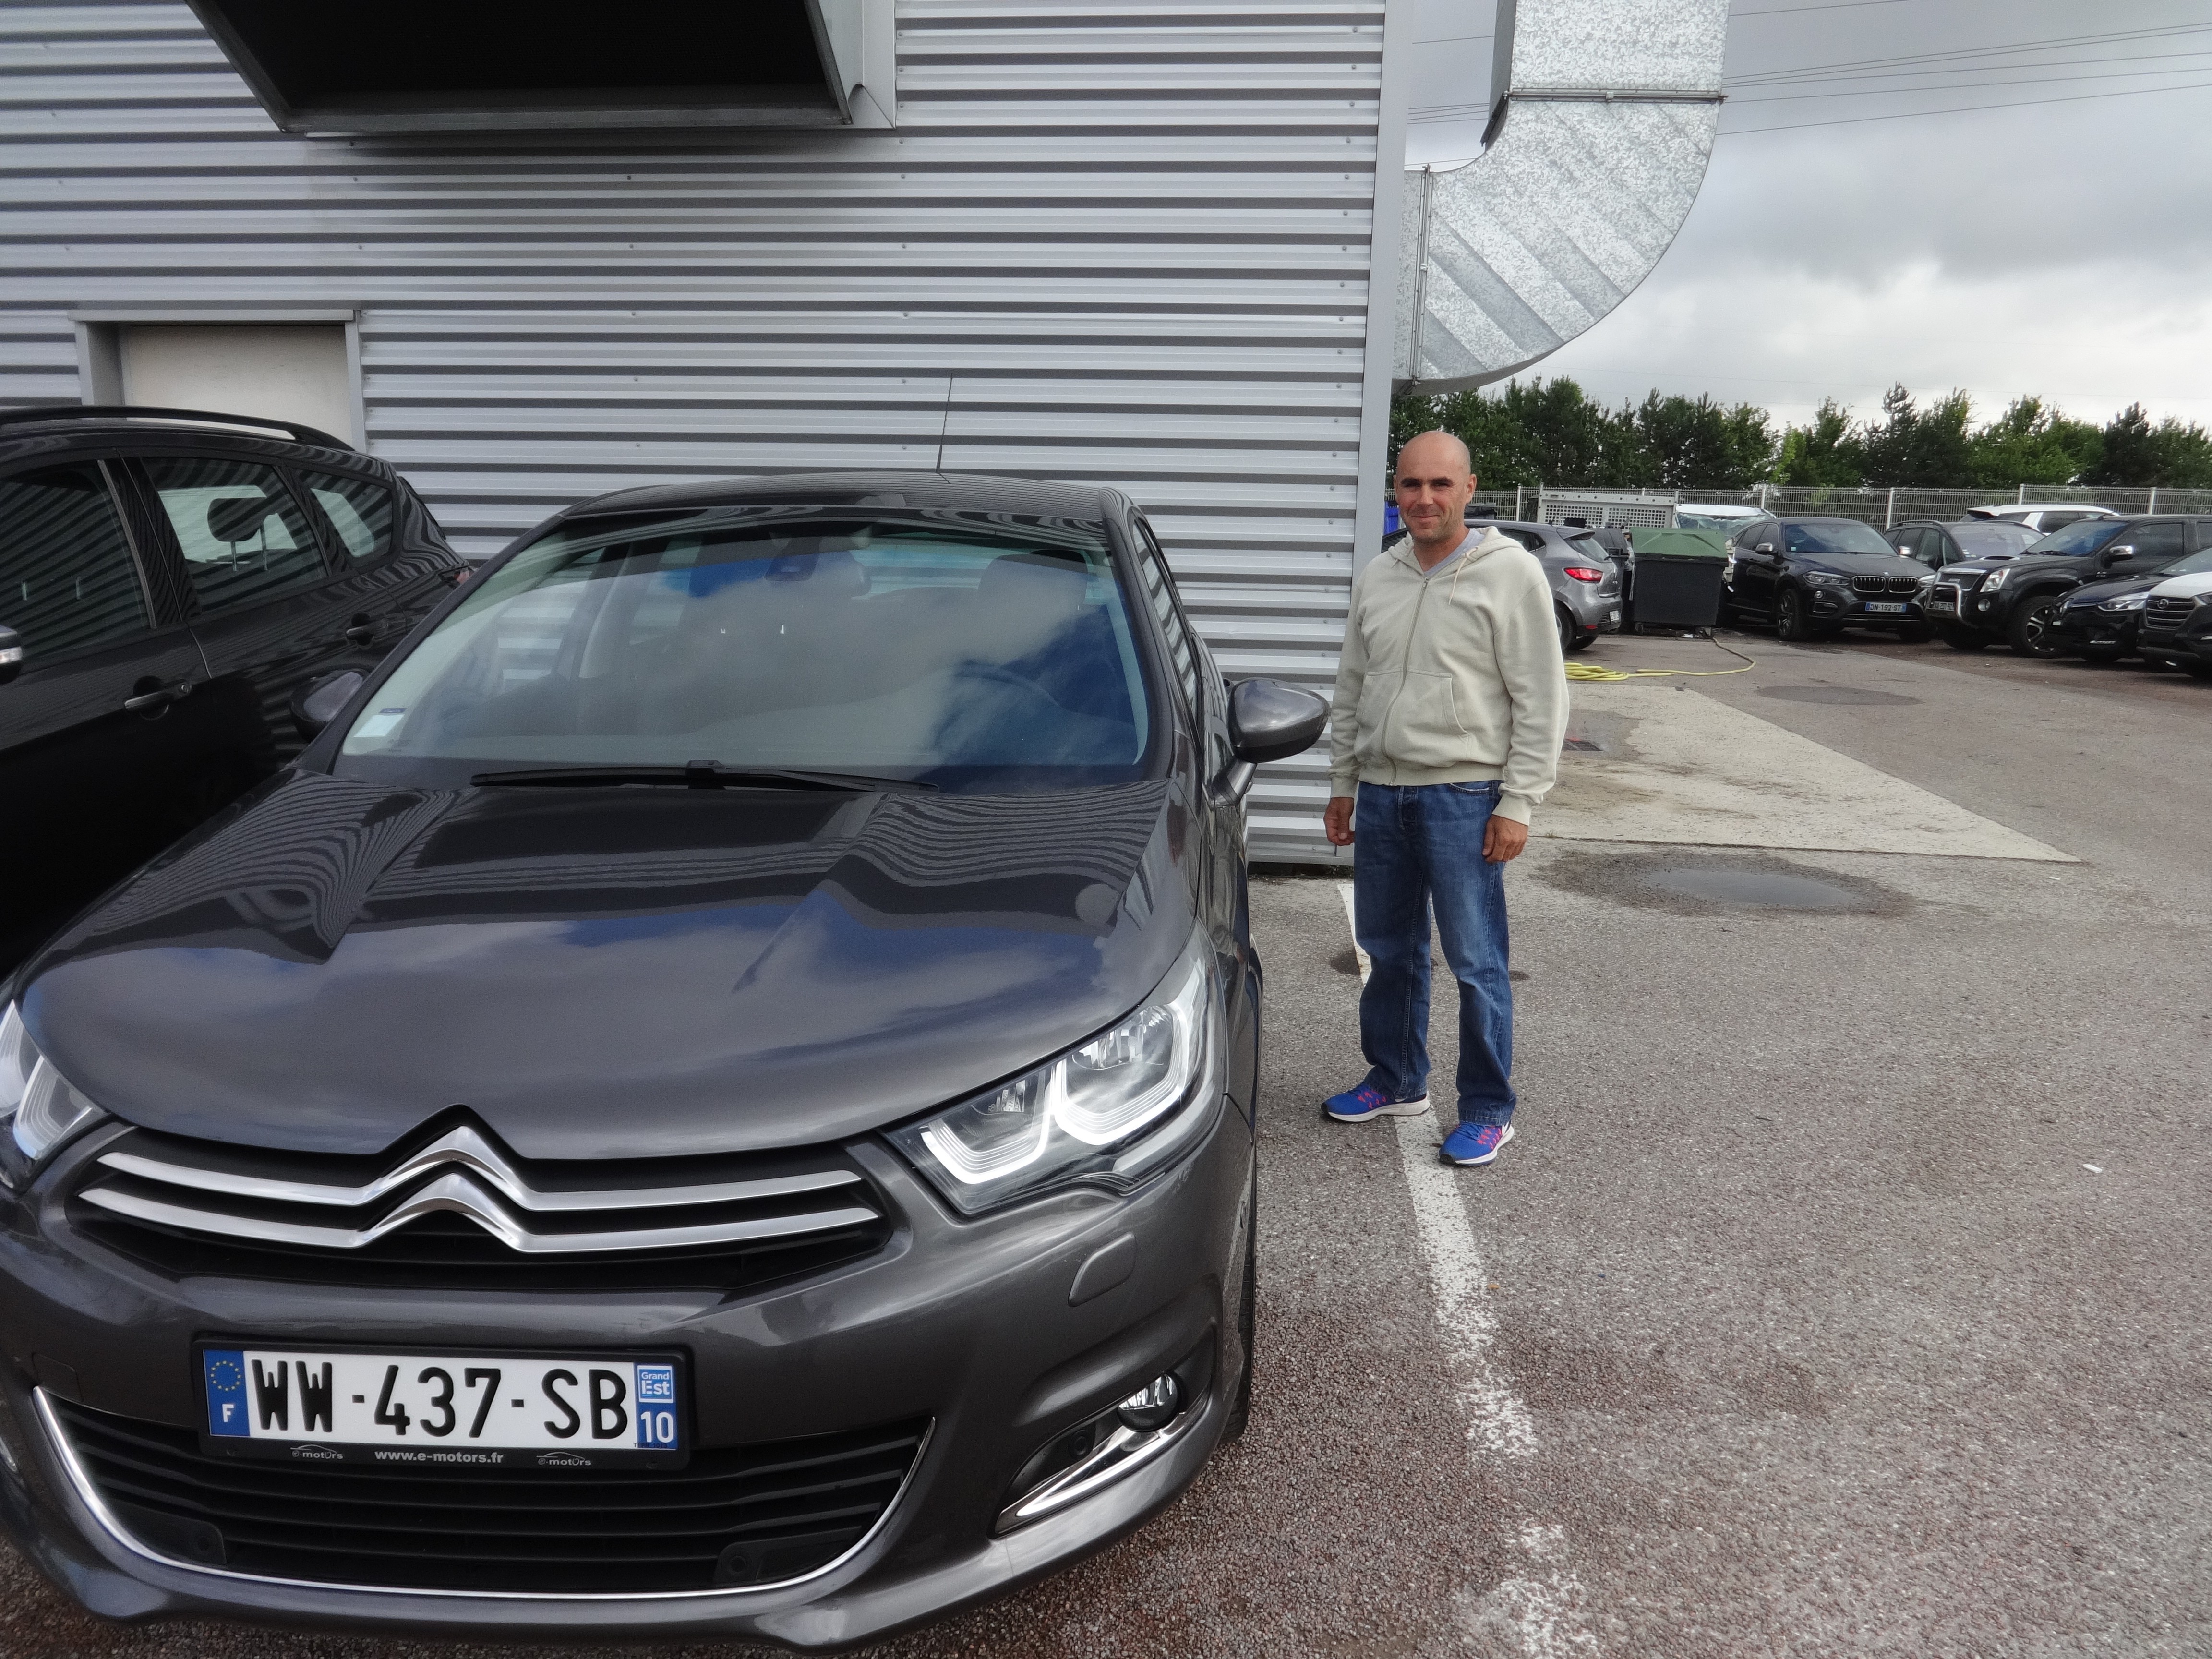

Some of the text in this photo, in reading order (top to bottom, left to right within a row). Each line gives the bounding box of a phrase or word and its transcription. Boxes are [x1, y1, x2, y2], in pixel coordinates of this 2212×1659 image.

[641, 1380, 670, 1395] Est
[252, 1359, 627, 1439] WW-437-SB
[222, 1404, 234, 1422] F
[641, 1411, 674, 1443] 10
[374, 1451, 504, 1463] www.e-motors.fr
